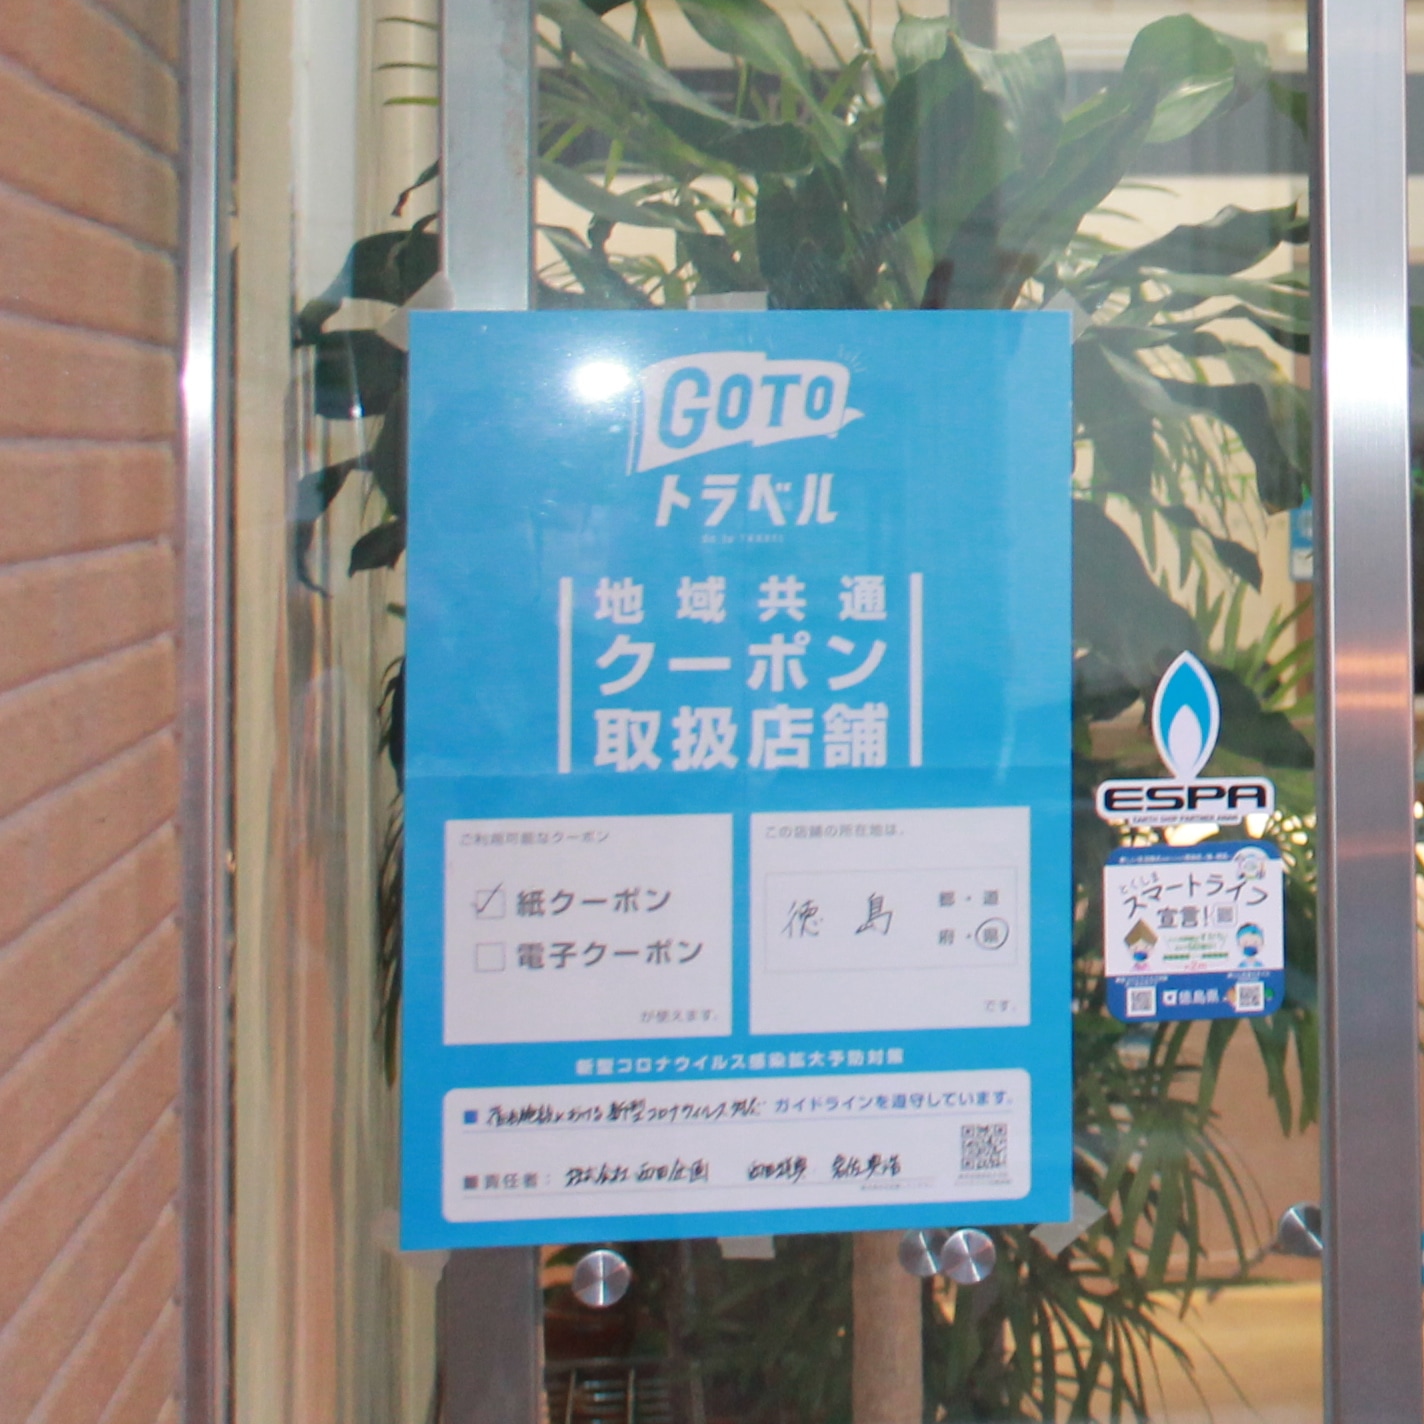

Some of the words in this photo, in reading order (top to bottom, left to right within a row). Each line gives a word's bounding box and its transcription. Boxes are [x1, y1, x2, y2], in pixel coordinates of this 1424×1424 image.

[655, 473, 838, 528] トラベル
[594, 576, 888, 625] 地域共通
[595, 631, 888, 697] クーポン
[593, 702, 890, 772] 取扱店舗
[1103, 784, 1268, 813] ESPA
[459, 830, 610, 847] ご利用可能なクーポン
[516, 887, 671, 917] 紙クーポン
[1123, 872, 1269, 920] スマートライン
[517, 939, 704, 970] 電子クーポン
